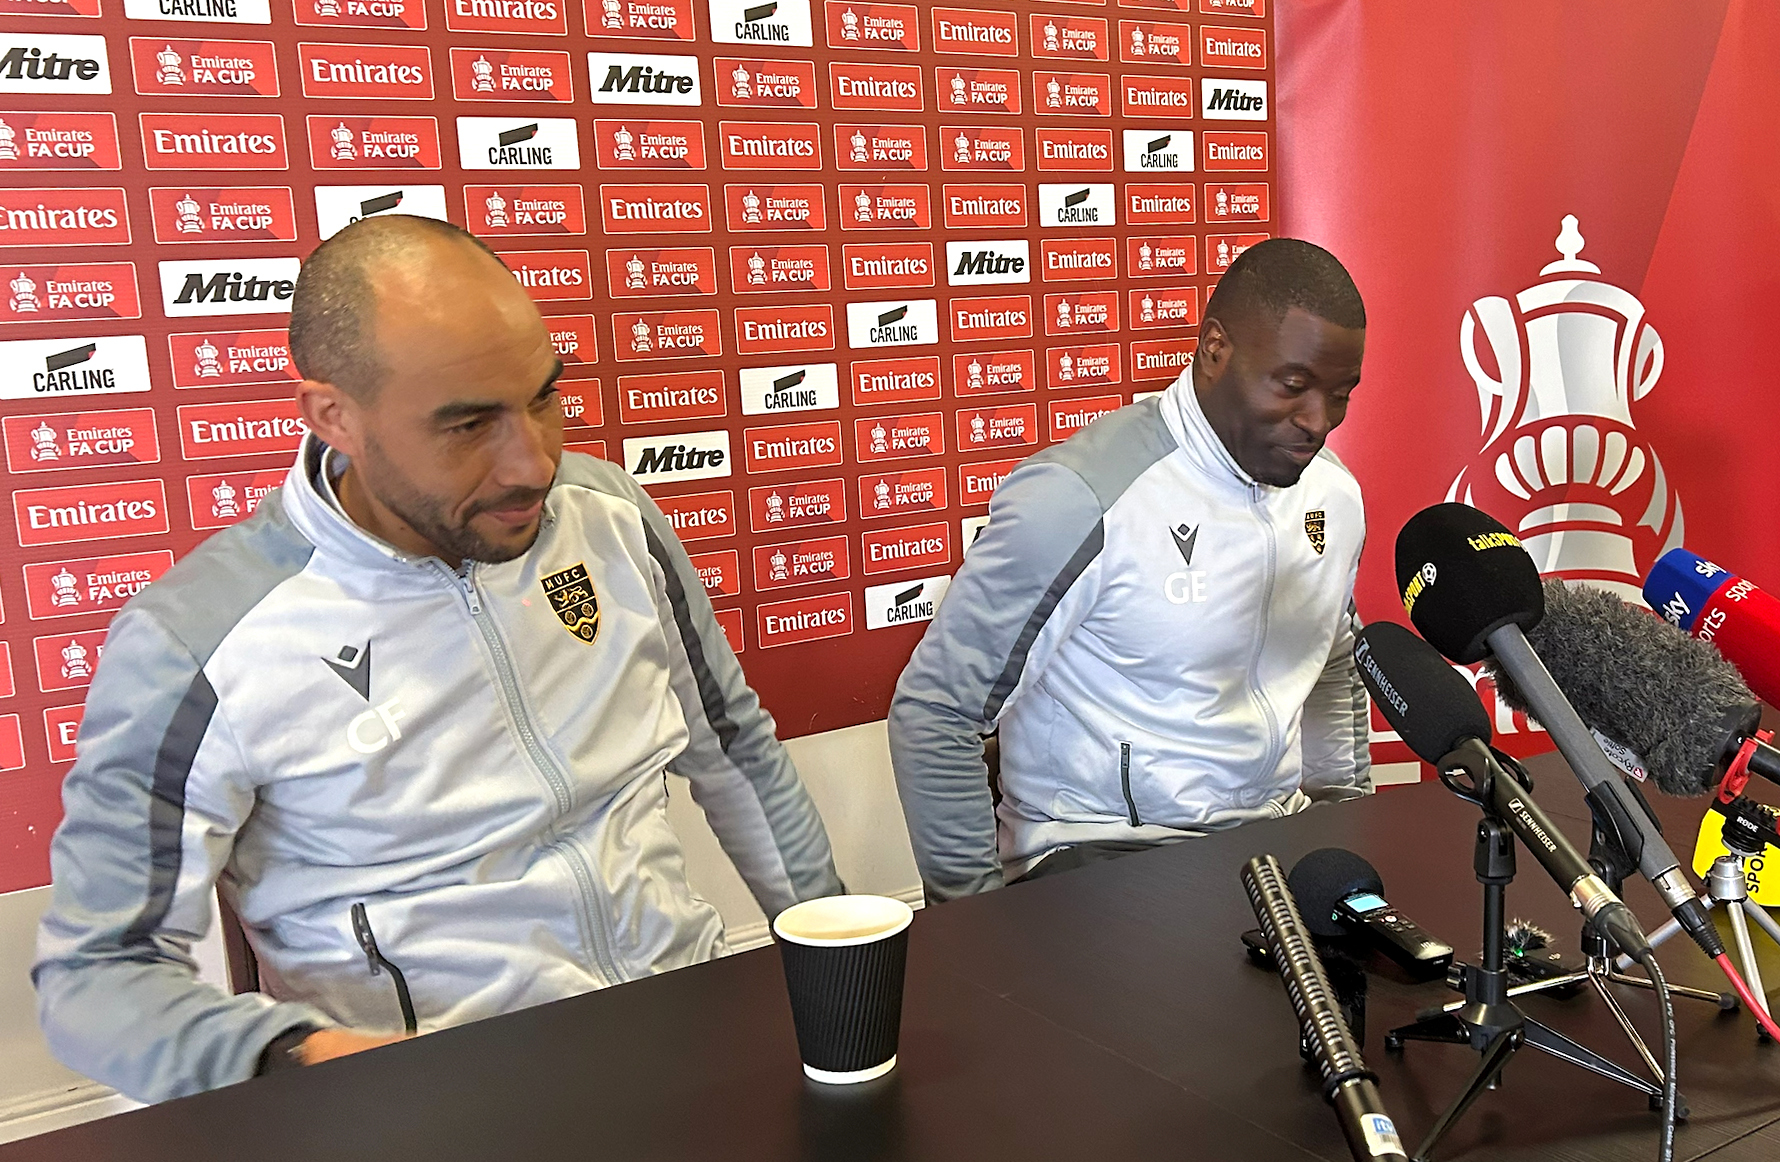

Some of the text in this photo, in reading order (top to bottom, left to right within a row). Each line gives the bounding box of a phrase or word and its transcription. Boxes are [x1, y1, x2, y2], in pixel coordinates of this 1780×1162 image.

[159, 0, 236, 17] CARLING
[348, 2, 404, 16] FA CUP
[456, 0, 557, 19] Emirates
[628, 3, 675, 15] Emirates
[630, 15, 676, 28] FA CUP
[864, 16, 903, 28] Emirates
[736, 23, 789, 41] CARLING
[865, 28, 904, 40] FA CUP
[940, 21, 1011, 43] Emirates
[1062, 29, 1095, 39] Emirates
[1063, 39, 1096, 50] FA CUP
[1206, 38, 1261, 57] Emirates
[191, 56, 253, 69] Emirates
[193, 69, 255, 83] FA CUP
[311, 59, 423, 83] Emirates
[500, 65, 552, 76] Emirates
[502, 77, 553, 90] FA CUP
[598, 66, 693, 93] Mitre
[756, 73, 799, 84] Emirates
[757, 85, 800, 97] FA CUP
[838, 77, 916, 97] Emirates
[971, 81, 1007, 91] Emirates
[972, 92, 1007, 103] FA CUP
[1128, 88, 1187, 106] Emirates
[1207, 89, 1262, 111] Mitre
[25, 129, 92, 141] Emirates
[153, 130, 276, 153] Emirates
[362, 132, 418, 143] Emirates
[28, 143, 94, 157] FA CUP
[729, 136, 813, 156] Emirates
[872, 138, 911, 148] Emirates
[1043, 141, 1107, 158] Emirates
[364, 145, 419, 157] FA CUP
[489, 147, 552, 164] CARLING
[873, 149, 912, 160] FA CUP
[1209, 143, 1263, 159] Emirates
[1141, 154, 1177, 167] CARLING
[514, 199, 564, 210] Emirates
[877, 197, 915, 207] Emirates
[951, 196, 1020, 215] Emirates
[1132, 196, 1190, 212] Emirates
[1231, 195, 1258, 203] Emirates
[210, 203, 271, 215] Emirates
[611, 199, 702, 219] Emirates
[878, 208, 916, 219] FA CUP
[1058, 208, 1098, 222] CARLING
[1231, 204, 1259, 213] FA CUP
[212, 216, 272, 229] FA CUP
[515, 212, 566, 224] FA CUP
[652, 262, 697, 272] Emirates
[771, 259, 813, 269] Emirates
[851, 256, 927, 276] Emirates
[954, 251, 1024, 275] Mitre
[1048, 251, 1111, 269] Emirates
[512, 265, 583, 287] irates
[653, 273, 698, 285] FA CUP
[772, 270, 814, 282] FA CUP
[46, 280, 112, 293] Emirates
[173, 272, 294, 303] Mitre
[49, 293, 114, 308] FA CUP
[1075, 304, 1107, 313] Emirates
[957, 309, 1026, 328] Emirates
[1076, 313, 1107, 324] FA CUP
[657, 325, 703, 335] Emirates
[744, 320, 827, 340] Emirates
[870, 326, 917, 342] CARLING
[659, 335, 704, 348] FA CUP
[228, 346, 287, 358] Emirates
[230, 358, 289, 373] FA CUP
[1136, 351, 1194, 370] Emirates
[987, 364, 1021, 373] Emirates
[34, 369, 114, 392] CARLING
[859, 372, 934, 392] Emirates
[988, 373, 1022, 385] FA CUP
[628, 387, 717, 409] Emirates
[765, 390, 816, 409] CARLING
[990, 418, 1023, 428] Emirates
[67, 427, 132, 441] Emirates
[190, 417, 307, 444] Emirates
[892, 427, 929, 437] Emirates
[990, 426, 1024, 439] FA CUP
[69, 439, 134, 456] FA CUP
[753, 438, 834, 459] Emirates
[893, 436, 930, 449] FA CUP
[633, 446, 724, 475] Mitre
[895, 483, 932, 493] Emirates
[789, 494, 829, 506] Emirates
[896, 491, 933, 505] FA CUP
[28, 500, 155, 528] Emirates
[790, 503, 830, 518] FA CUP
[870, 538, 943, 561] Emirates
[793, 552, 833, 564] Emirates
[794, 561, 834, 575] FA CUP
[87, 570, 150, 586] Emirates
[89, 586, 112, 601] FA
[1164, 570, 1208, 604] GE
[888, 602, 933, 622] CARLING
[1663, 592, 1691, 627] sky
[766, 609, 845, 634] Emirates
[1363, 654, 1409, 717] SENNHEISER
[347, 696, 406, 753] CF
[1604, 747, 1635, 772] Rycote
[1519, 811, 1557, 853] SENNHEISER
